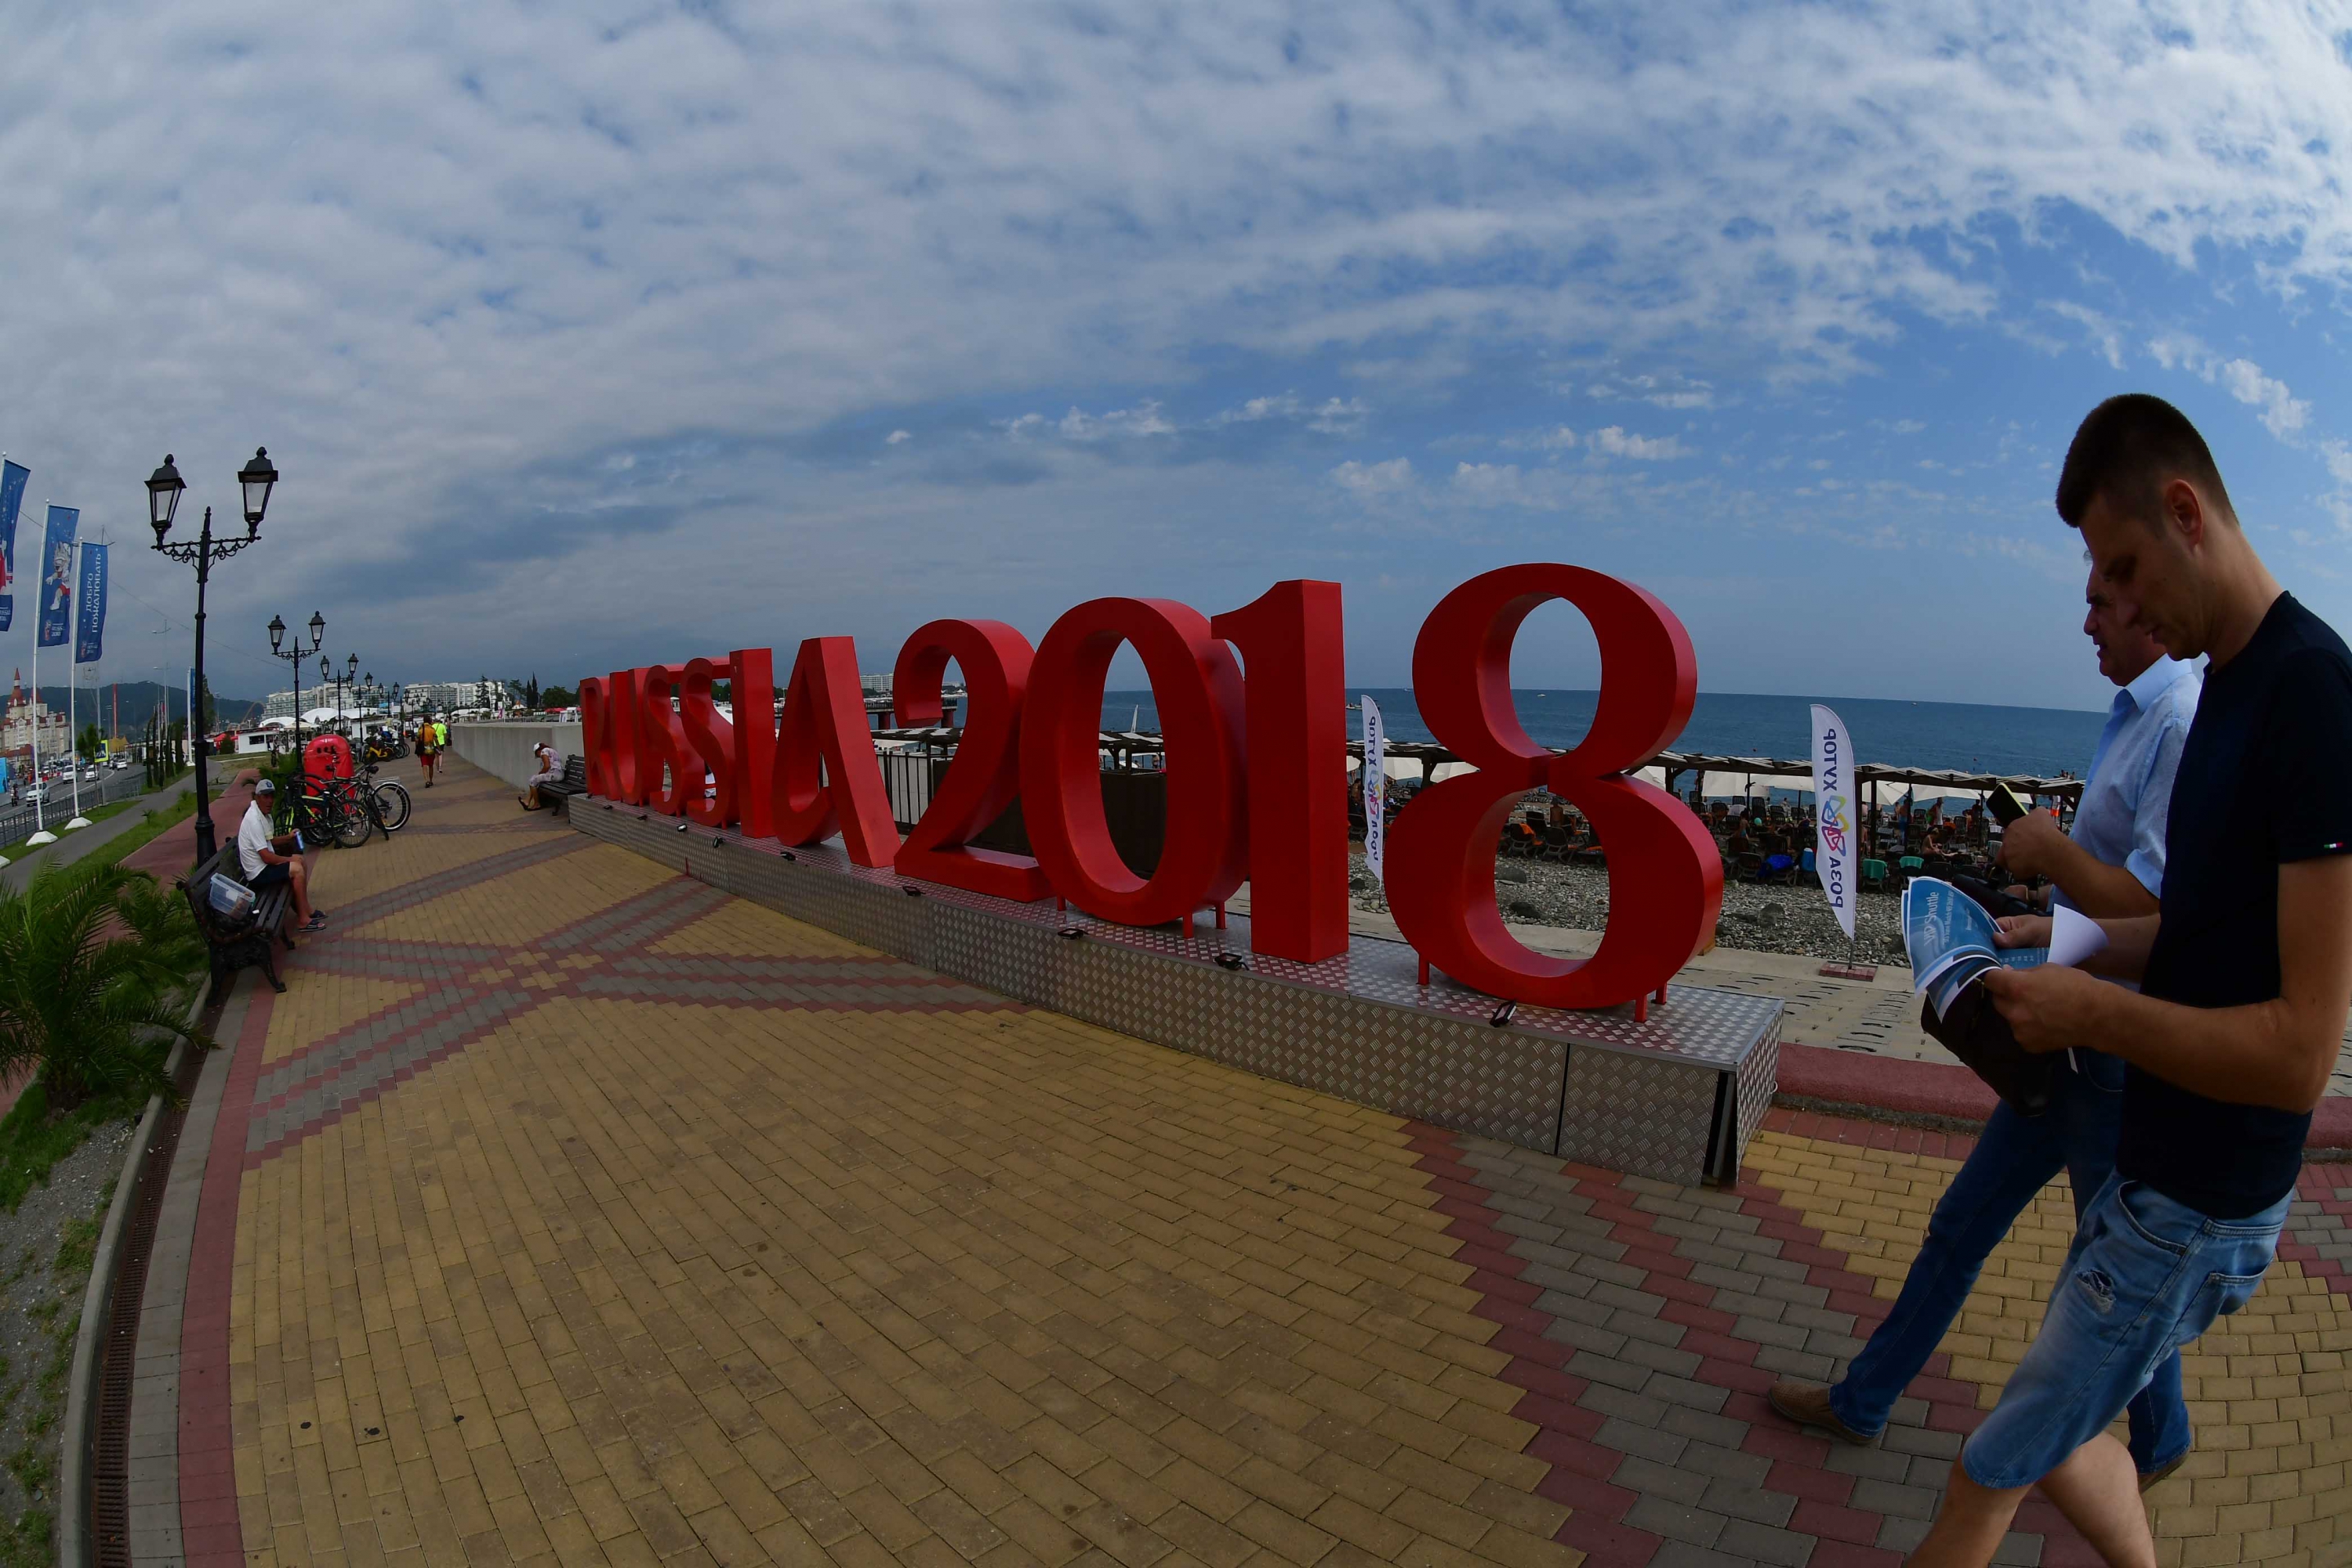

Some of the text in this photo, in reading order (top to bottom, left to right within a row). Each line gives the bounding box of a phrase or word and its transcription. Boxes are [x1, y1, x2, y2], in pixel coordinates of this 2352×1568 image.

[92, 554, 101, 633] ПОЖАЛОВАТЬ
[580, 562, 1723, 1009] RUSSIA 2018
[1923, 892, 1939, 946] VIP Shuttle
